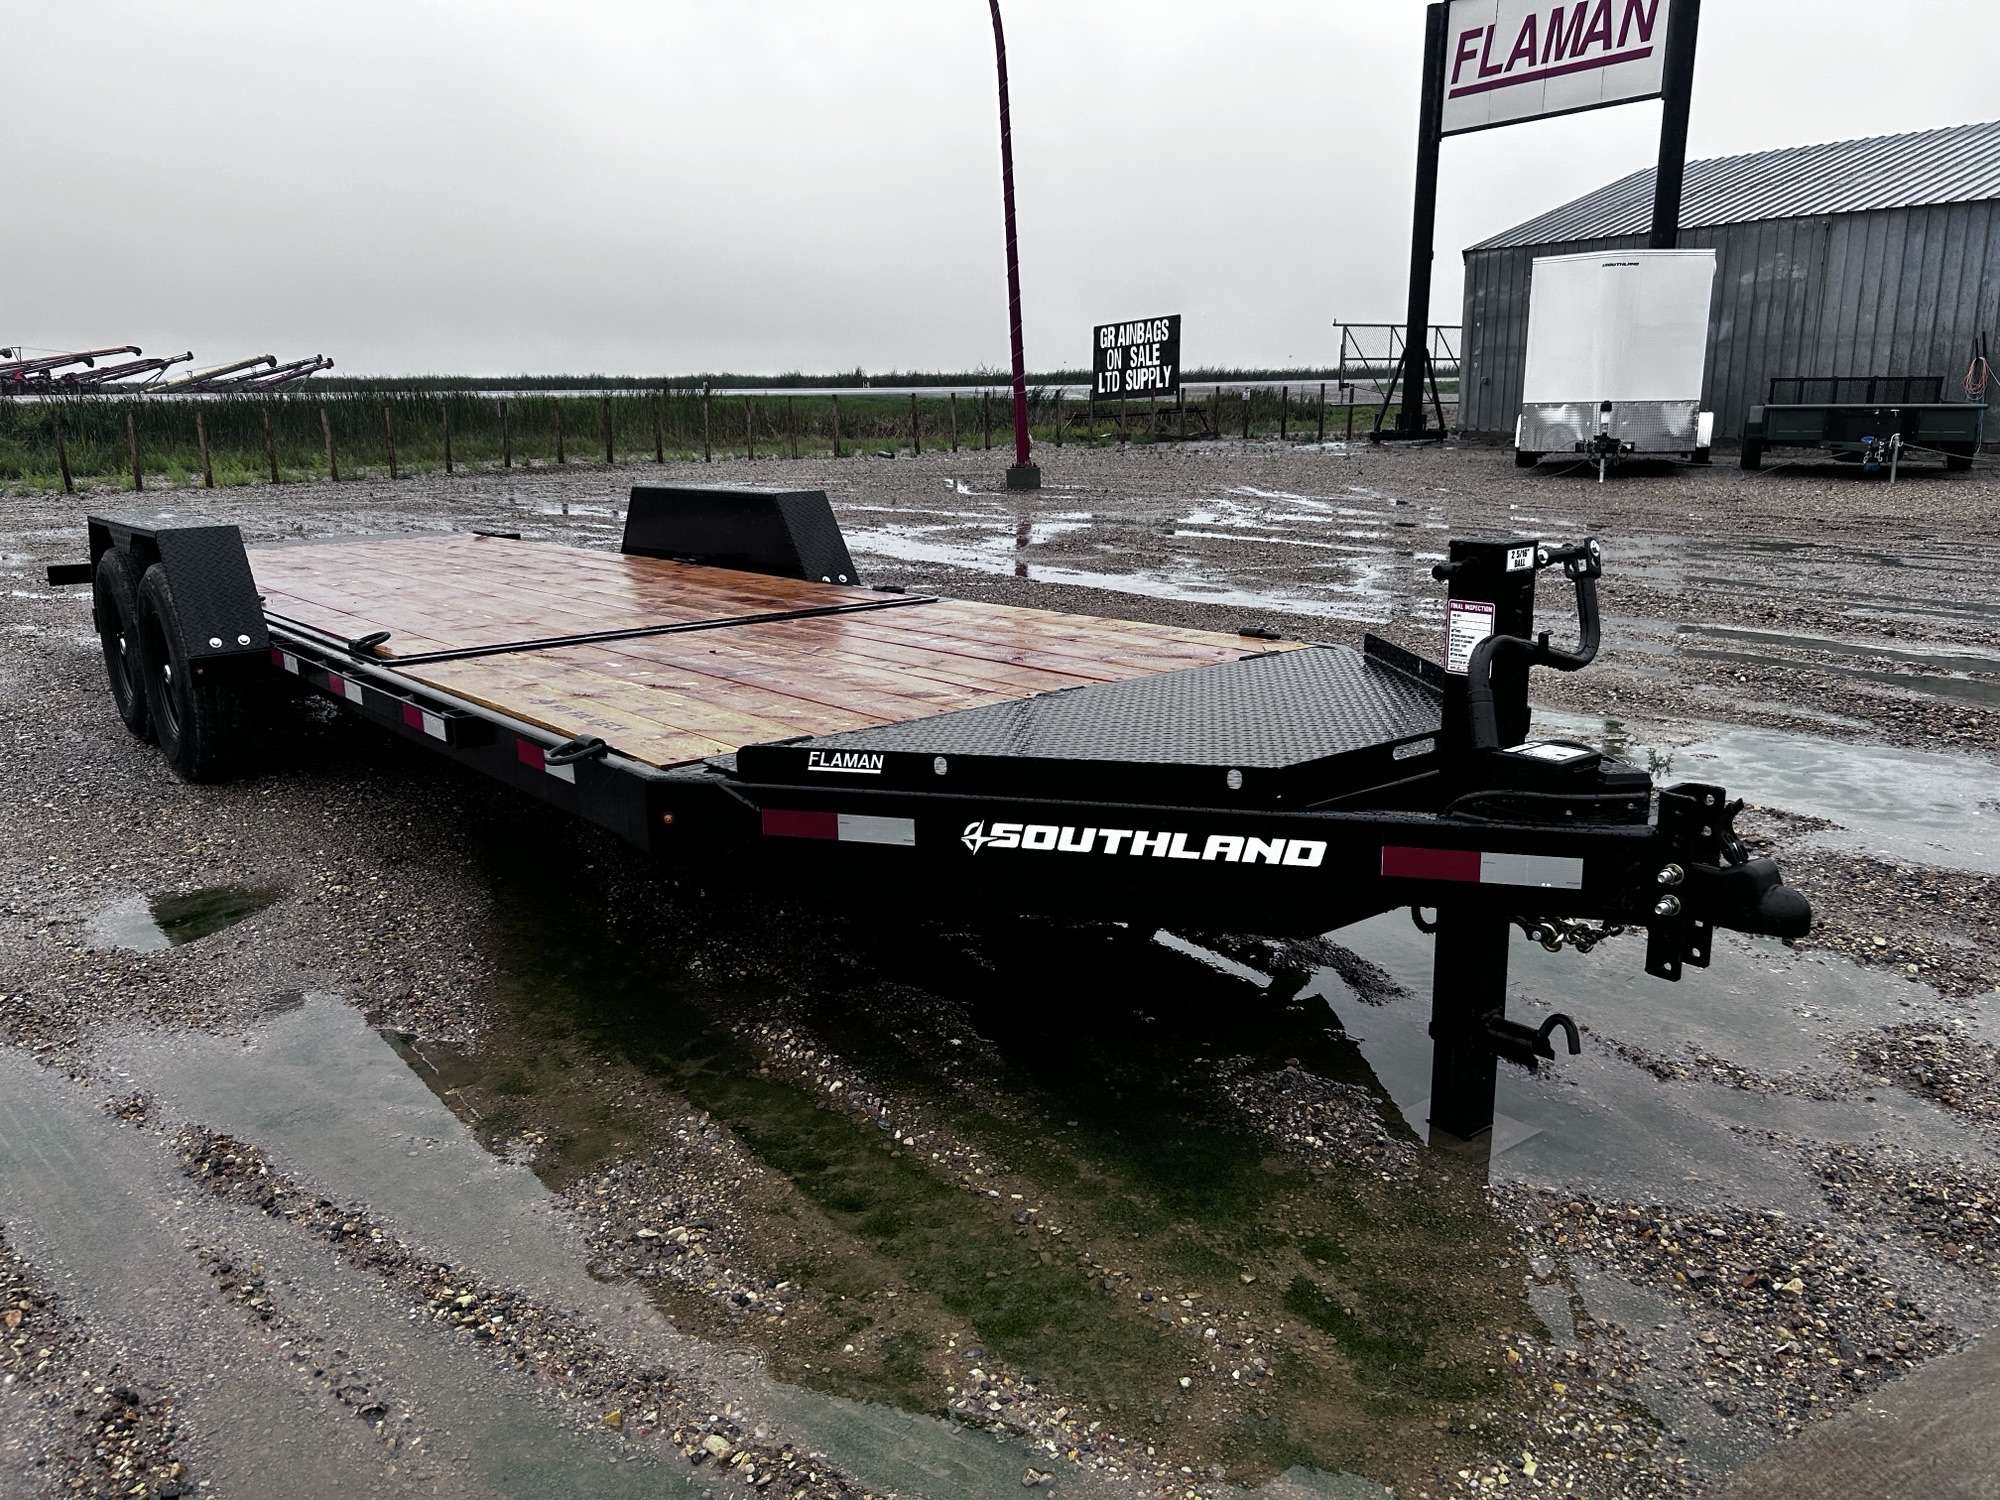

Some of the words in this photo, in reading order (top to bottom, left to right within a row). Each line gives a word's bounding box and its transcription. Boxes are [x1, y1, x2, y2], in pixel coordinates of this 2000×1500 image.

[1451, 0, 1658, 84] FLAMAN
[1100, 319, 1169, 348] GRAINBAGS
[1106, 347, 1121, 370] ON
[1130, 343, 1160, 367] SALE
[1098, 371, 1119, 393] LTD
[1125, 365, 1172, 390] SUPPLY
[1511, 550, 1516, 559] 2
[1514, 559, 1526, 568] BALL
[1464, 605, 1493, 613] INSPECTION
[808, 751, 884, 769] FLAMAN
[985, 823, 1327, 868] SOUTHLAND
